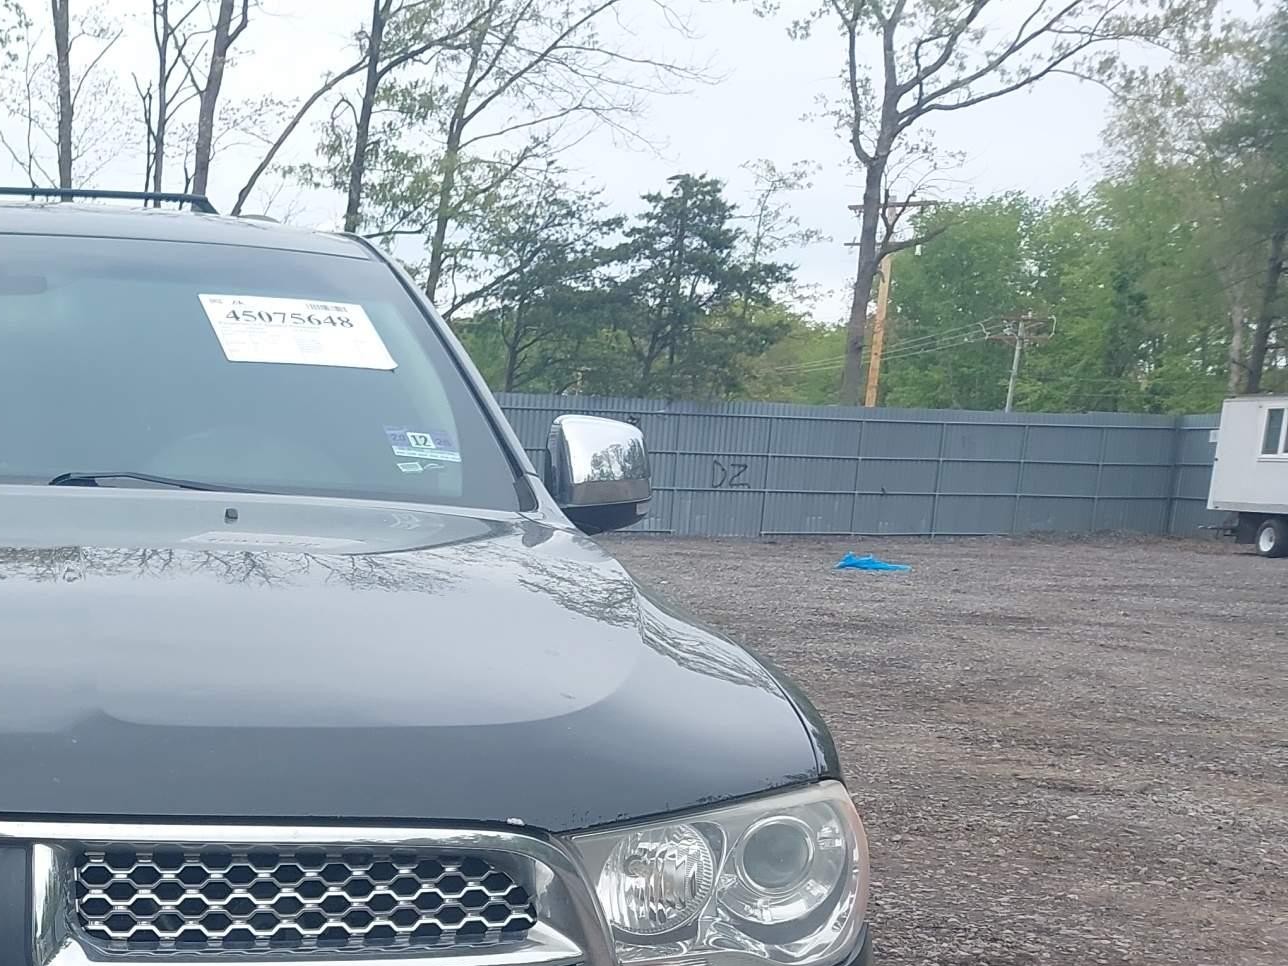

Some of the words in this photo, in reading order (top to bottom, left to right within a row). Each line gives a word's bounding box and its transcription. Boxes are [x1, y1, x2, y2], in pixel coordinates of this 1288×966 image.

[225, 309, 355, 329] 45075648
[410, 434, 433, 447] 12
[711, 459, 752, 489] DZ
